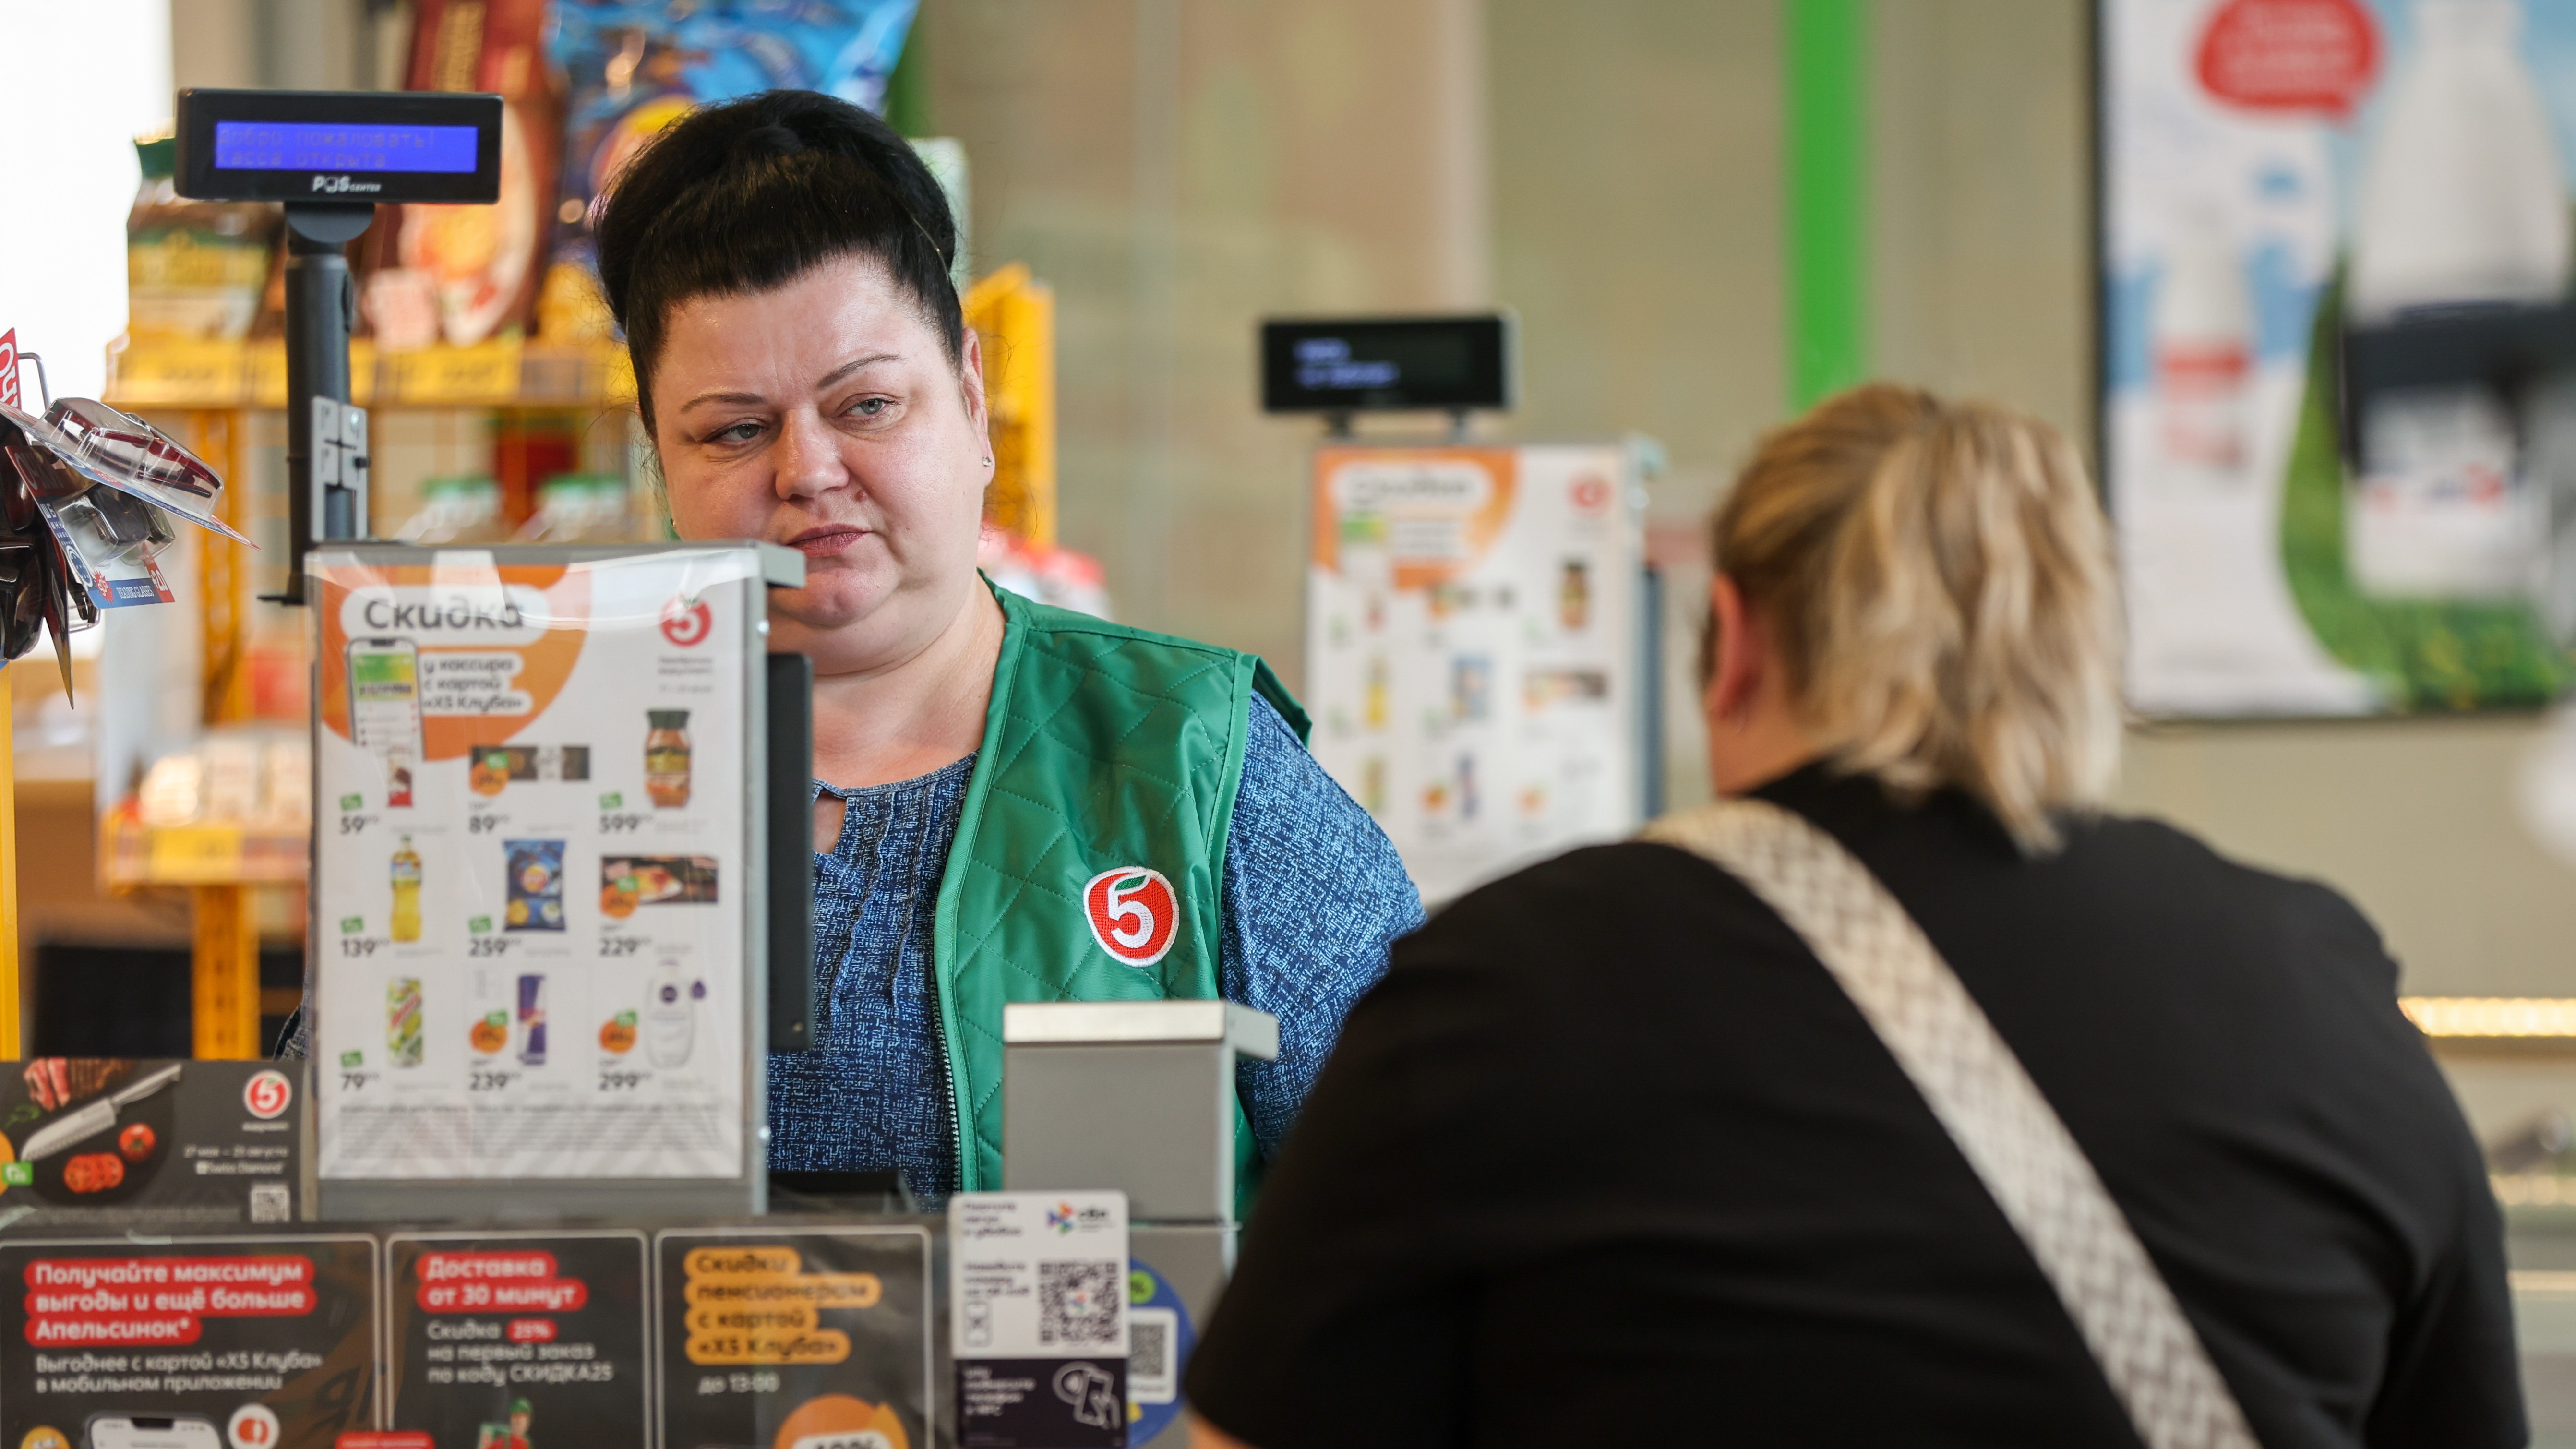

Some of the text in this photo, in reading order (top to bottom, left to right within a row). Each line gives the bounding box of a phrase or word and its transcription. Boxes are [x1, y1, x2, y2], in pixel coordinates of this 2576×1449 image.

[364, 594, 525, 630] Скидка
[439, 659, 514, 675] кассира
[436, 677, 502, 694] картой
[1107, 873, 1155, 949] 5
[36, 1262, 303, 1290] Получайте максимум
[426, 1255, 547, 1282] Доставка
[36, 1287, 305, 1312] выгоды и ещё больше
[427, 1282, 576, 1310] от 30 минут
[696, 1283, 868, 1302] пенсионерам
[427, 1318, 502, 1340] Скидка
[697, 1306, 807, 1330] с картой
[36, 1353, 128, 1374] Выгоднее
[132, 1355, 142, 1371] с
[145, 1351, 212, 1374] картой
[427, 1341, 596, 1366] на первый заказ
[36, 1373, 283, 1395] в мобильном приложении
[428, 1360, 615, 1387] по коду СКИДКА25
[697, 1375, 727, 1396] до
